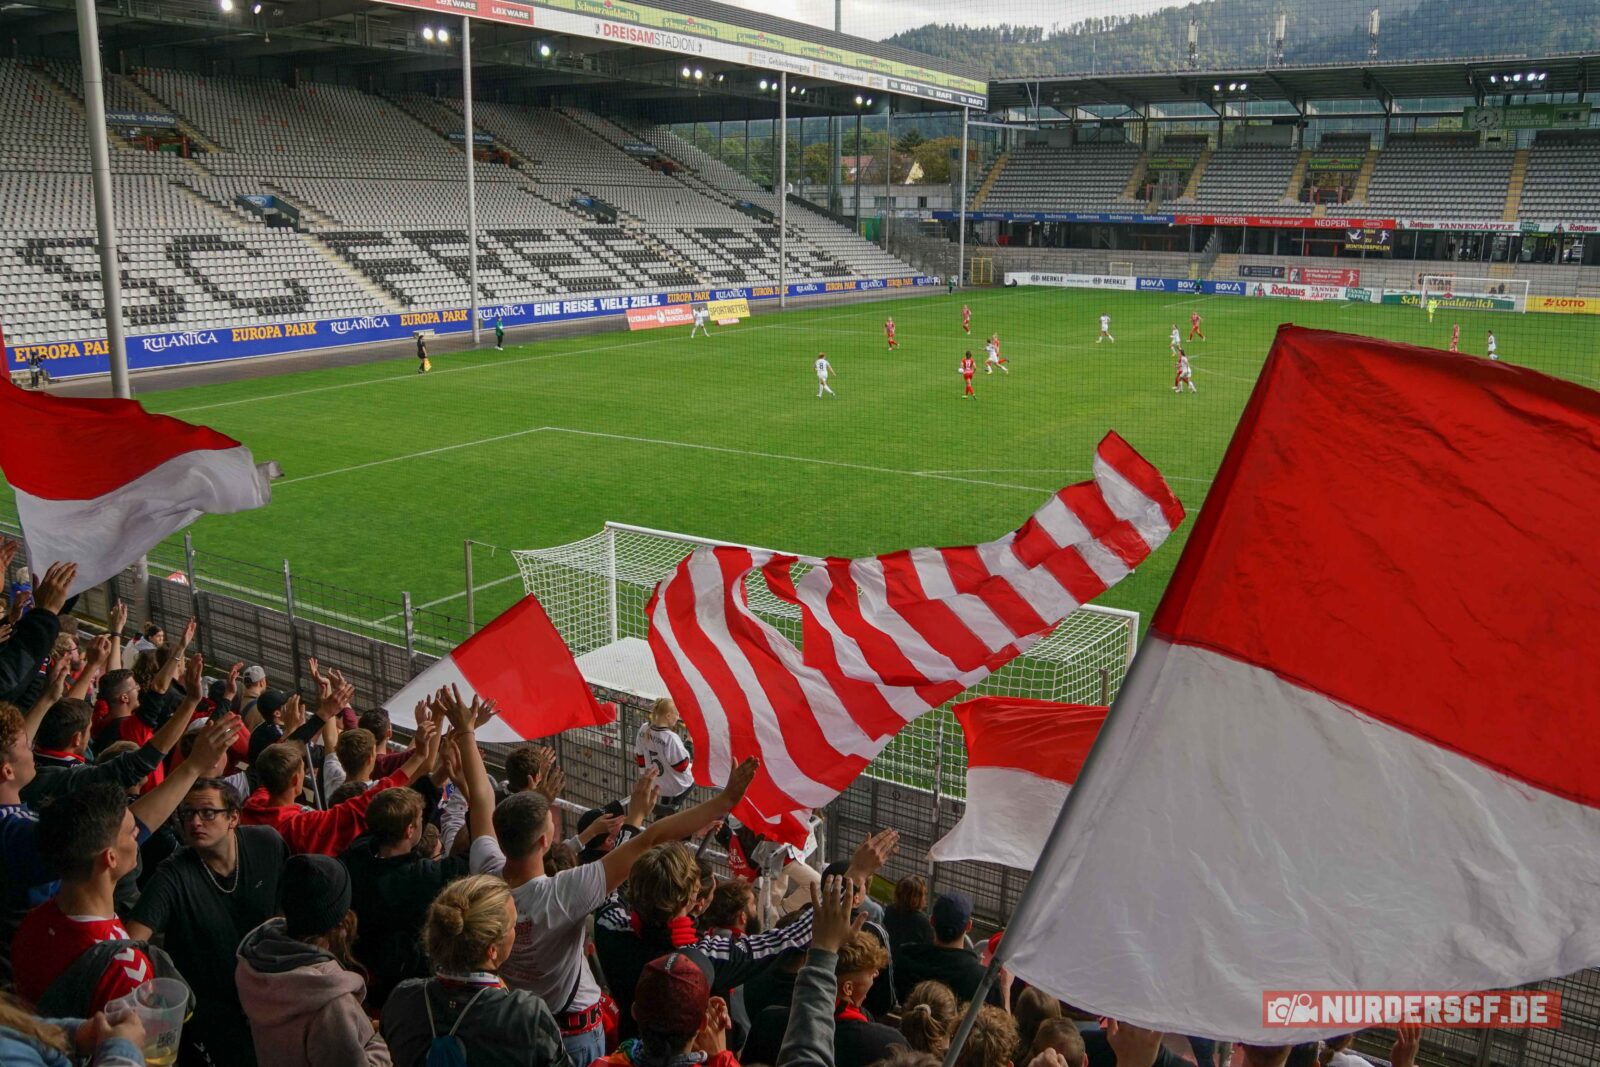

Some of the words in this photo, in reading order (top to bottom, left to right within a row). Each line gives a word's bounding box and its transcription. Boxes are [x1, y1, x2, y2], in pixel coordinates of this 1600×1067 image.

[603, 23, 695, 52] DREISAMSTADION
[901, 84, 918, 93] RAFI
[936, 91, 952, 100] RAFI
[1214, 217, 1248, 225] NEOPERL
[1314, 219, 1351, 228] NEOPERL
[752, 286, 774, 297] EUROPA
[1215, 282, 1233, 290] BGV
[1270, 283, 1306, 297] Rothaus
[667, 292, 692, 303] EUROPA
[694, 291, 710, 301] PARK
[715, 288, 747, 300] RULANTICA
[533, 301, 561, 317] EINE
[563, 299, 598, 314] REISE.
[600, 297, 629, 311] VIELE
[630, 294, 661, 308] ZIELE.
[709, 304, 749, 315] SPORTWETTEN
[1556, 299, 1586, 308] LOTTO
[400, 311, 441, 327] EUROPA
[442, 309, 468, 323] PARK
[478, 304, 525, 321] RULANTICA
[330, 315, 390, 335] RULANTICA
[232, 325, 282, 343] EUROPA
[285, 322, 317, 338] PARK
[142, 331, 218, 352] RULANTICA
[15, 342, 80, 363] EUROPA
[83, 340, 110, 356] PAR
[649, 750, 665, 777] 5
